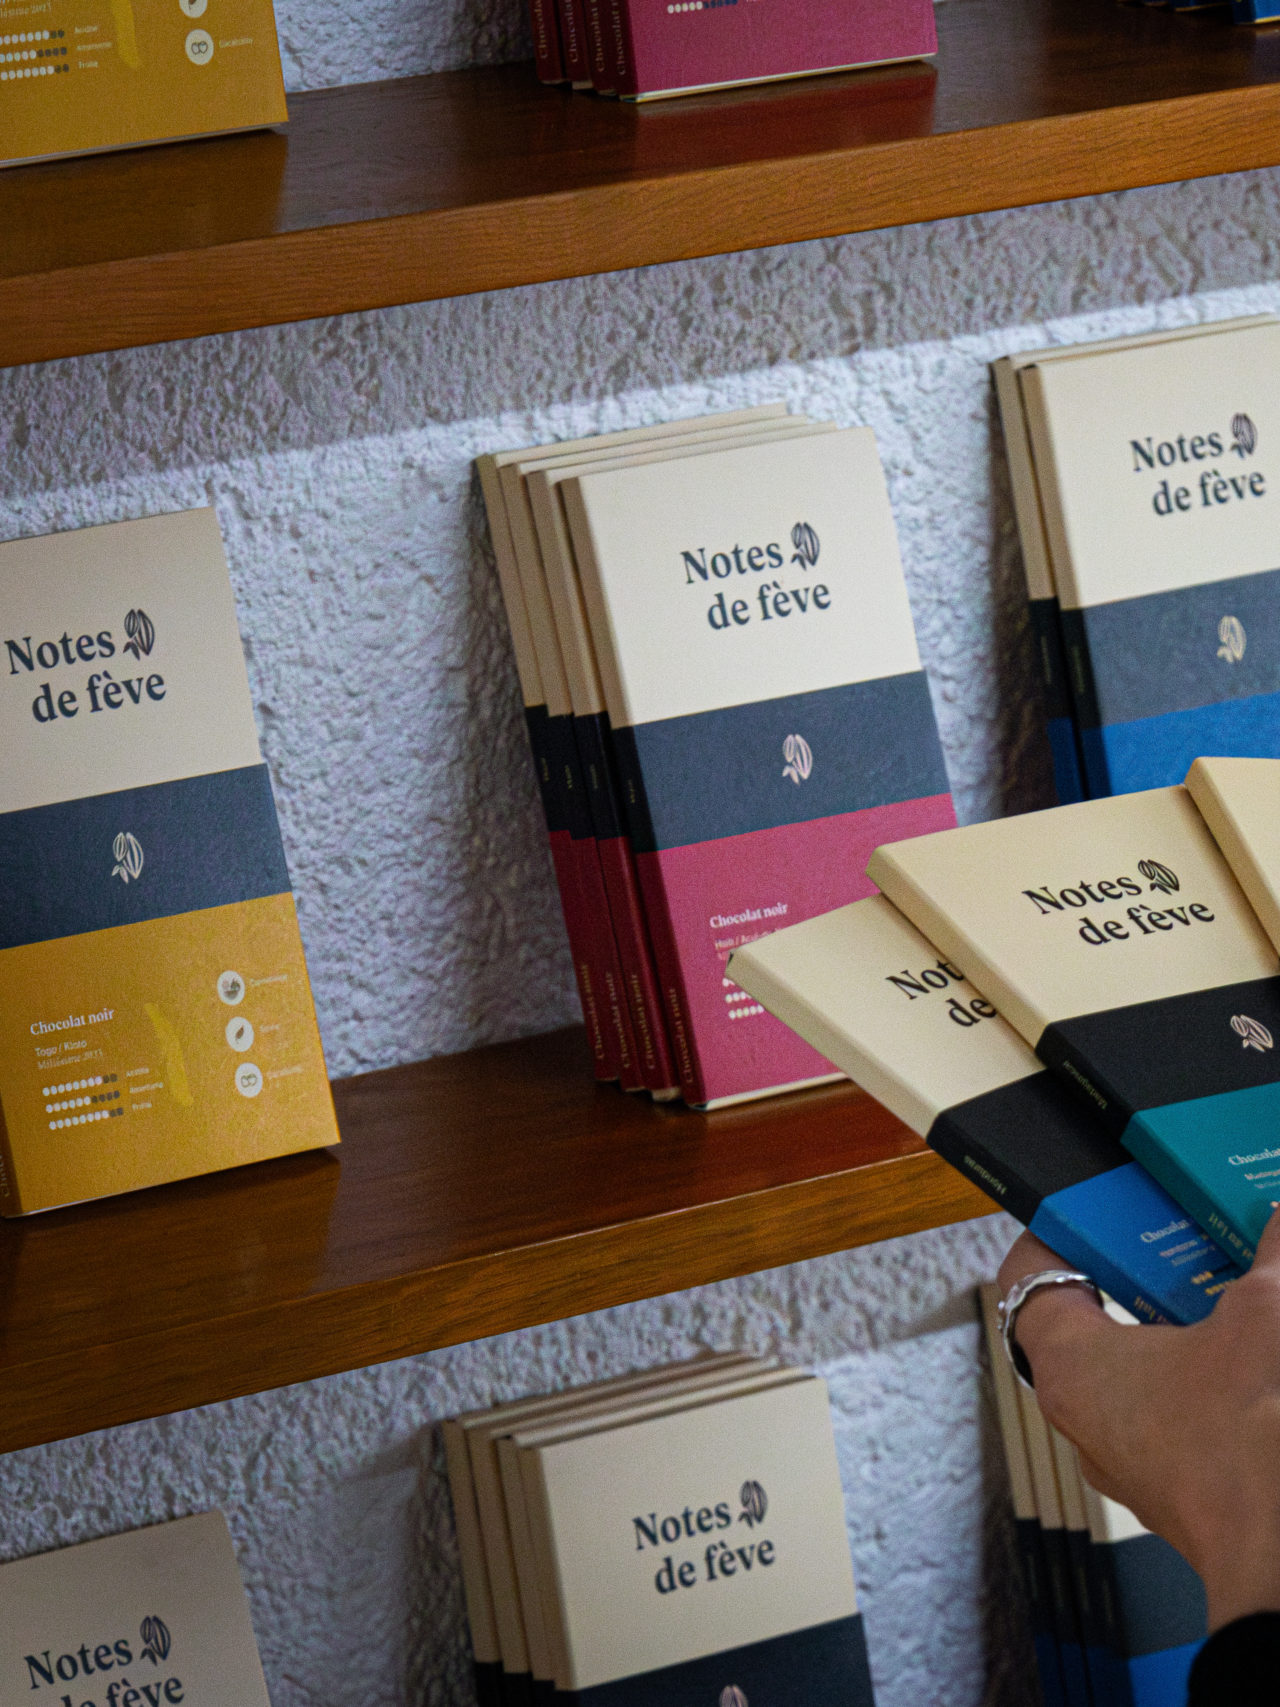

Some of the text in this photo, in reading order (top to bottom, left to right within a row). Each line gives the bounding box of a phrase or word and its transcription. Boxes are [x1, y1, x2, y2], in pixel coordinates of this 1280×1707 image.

[1129, 431, 1225, 473] Notes
[1152, 468, 1267, 517] de fève
[680, 542, 784, 585] Notes
[707, 580, 832, 630] de fève
[4, 631, 116, 675] Notes
[32, 670, 167, 723] de fève
[709, 902, 788, 928] Chocolat noir
[1022, 874, 1143, 916] Notes
[1078, 902, 1216, 946] de fève
[885, 959, 966, 1000] Not
[30, 1007, 115, 1035] Chocolat noir
[949, 998, 998, 1028] de
[631, 1502, 732, 1550] Notes
[654, 1539, 776, 1594] de fève
[24, 1638, 133, 1690] Notes
